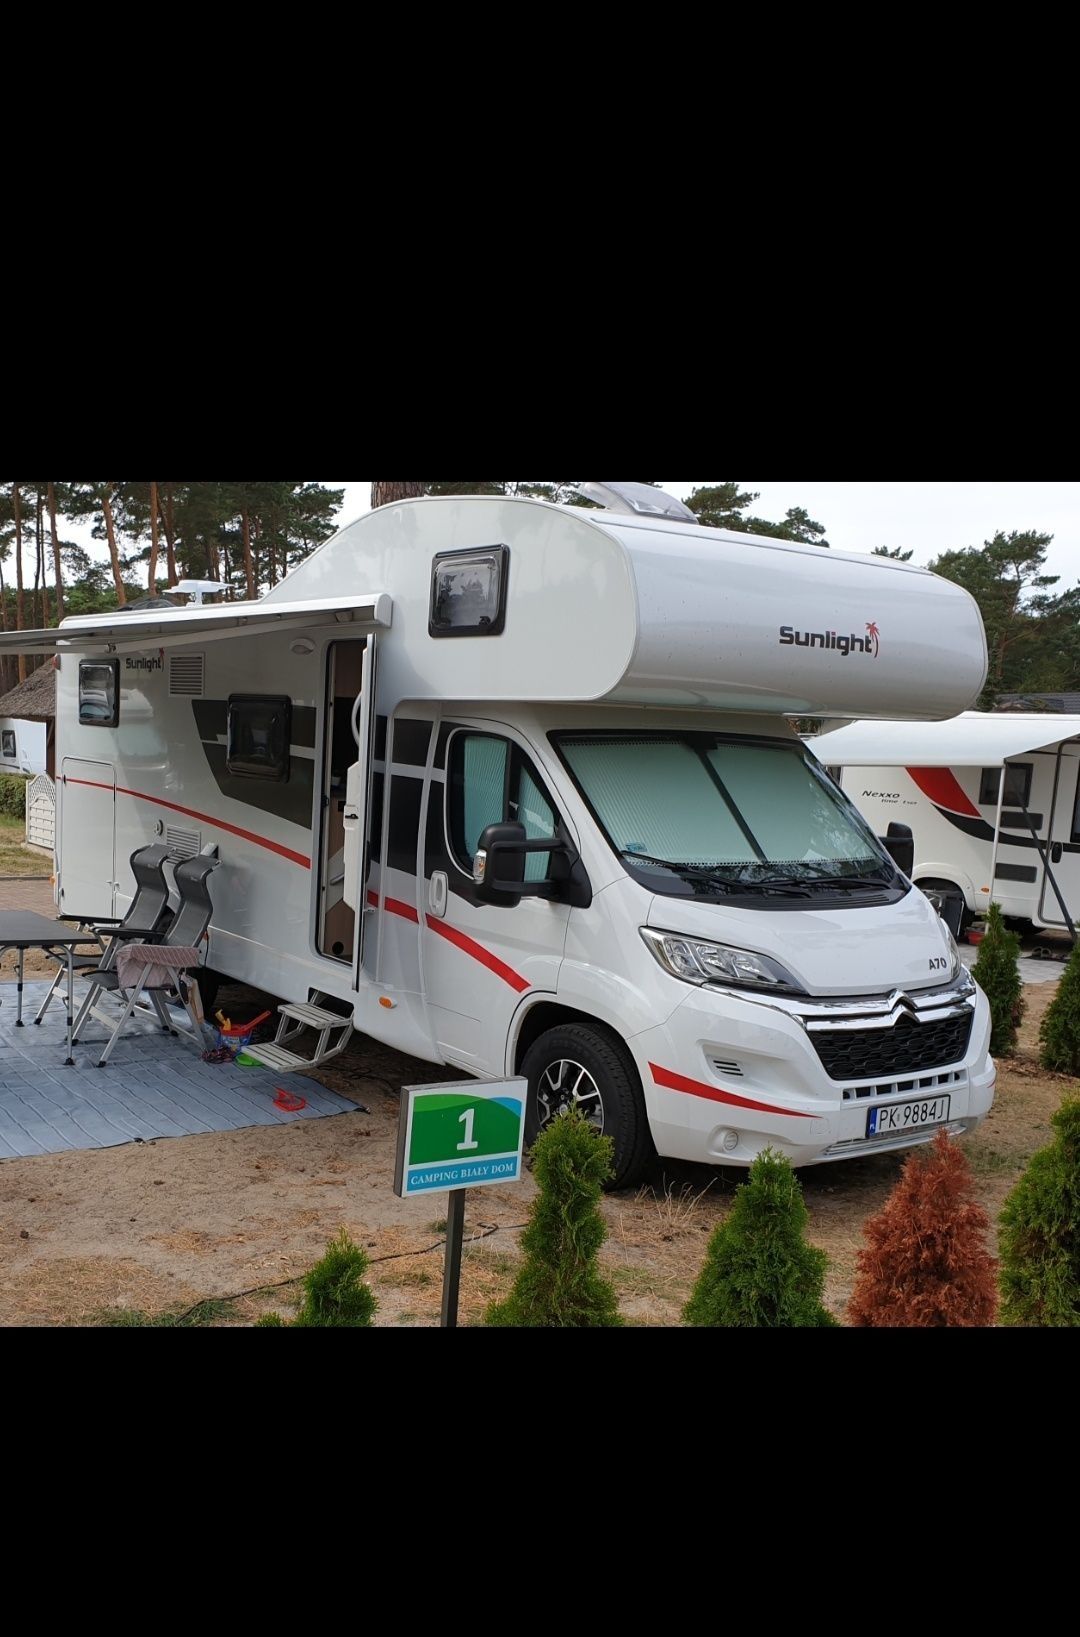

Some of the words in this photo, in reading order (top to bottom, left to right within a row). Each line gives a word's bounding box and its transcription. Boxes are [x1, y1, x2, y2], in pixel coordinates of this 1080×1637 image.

[779, 625, 872, 656] Sunlight
[125, 657, 162, 673] Sunlight
[861, 790, 900, 798] Nexxo
[929, 957, 947, 970] A70
[879, 1107, 899, 1129] PK
[903, 1099, 944, 1125] 9884J
[456, 1108, 478, 1150] 1
[411, 1170, 458, 1184] CAMPING
[461, 1166, 489, 1178] BIAŁY
[491, 1163, 514, 1174] DOM
